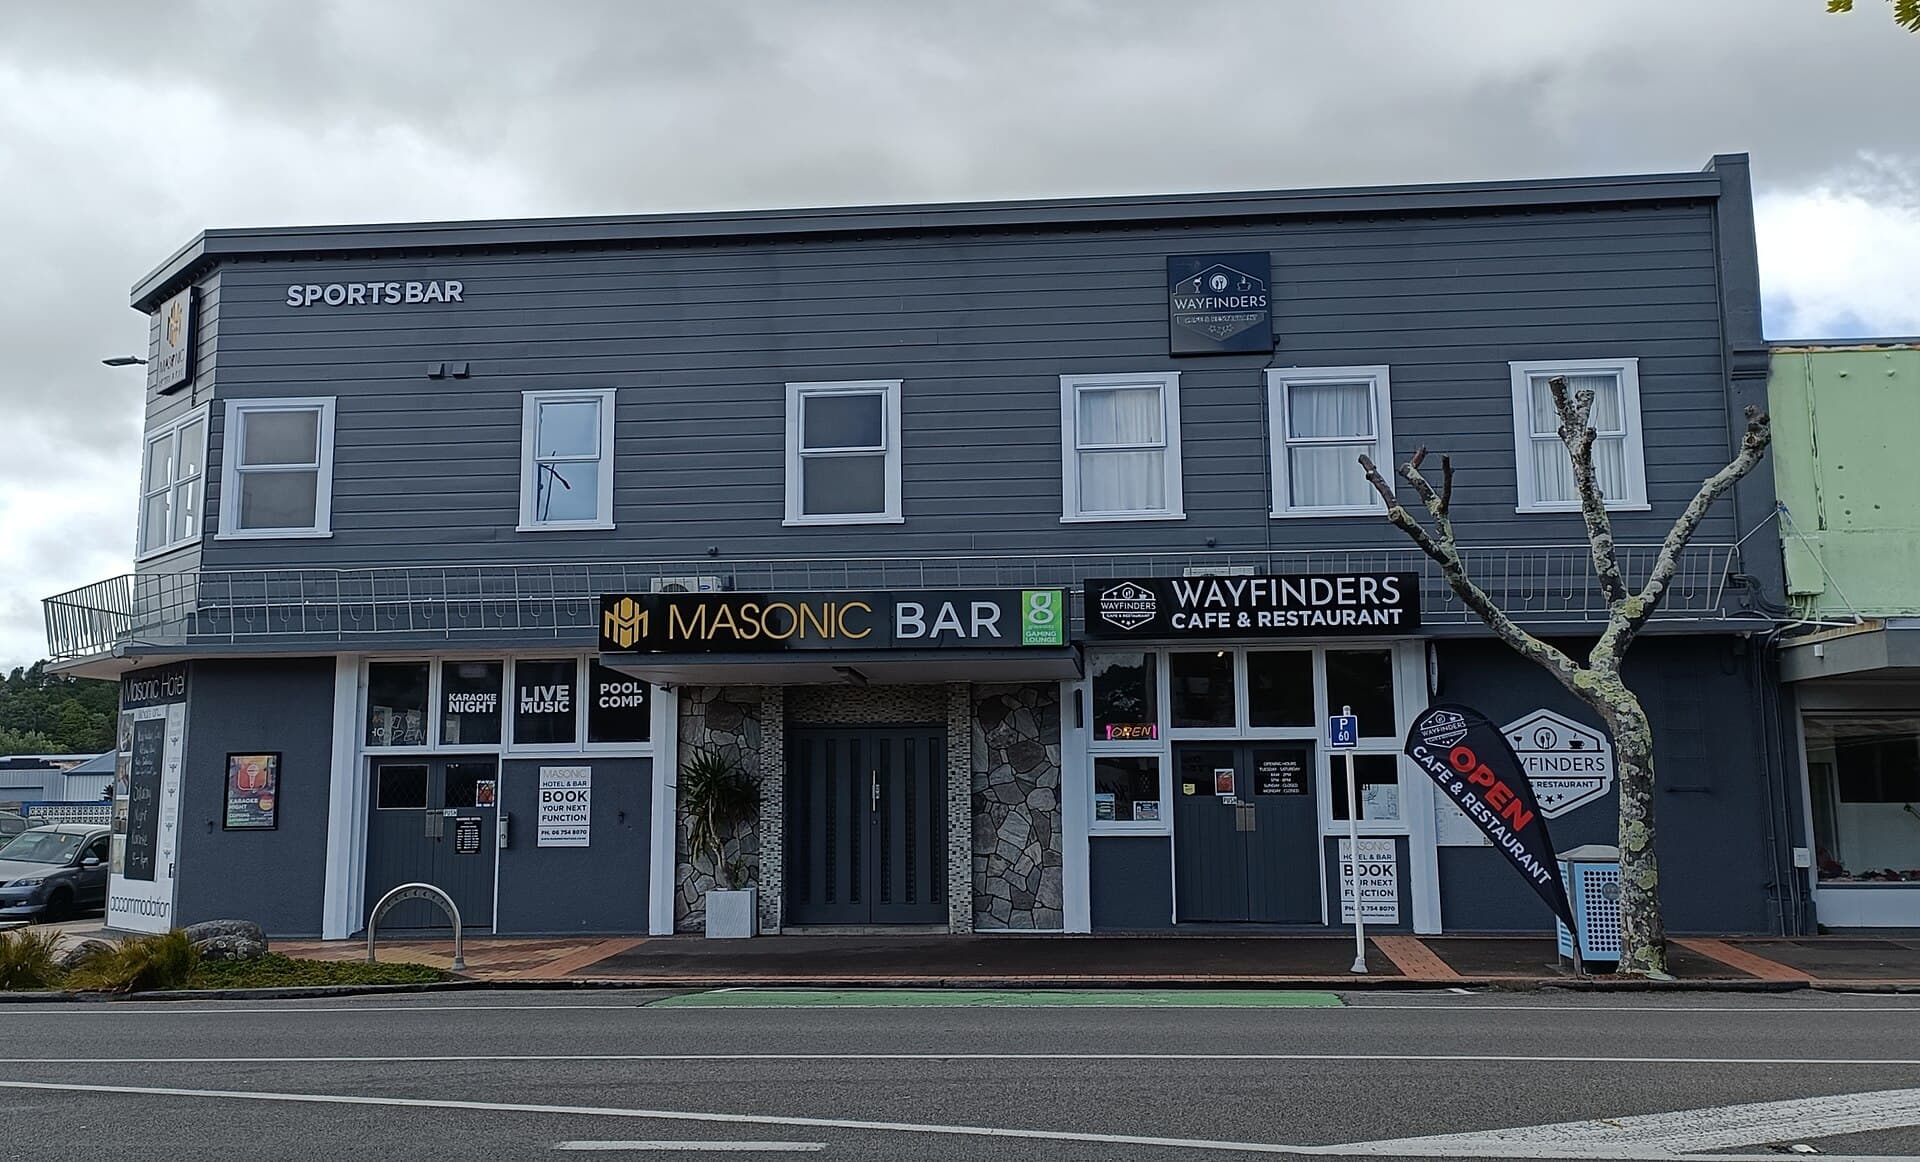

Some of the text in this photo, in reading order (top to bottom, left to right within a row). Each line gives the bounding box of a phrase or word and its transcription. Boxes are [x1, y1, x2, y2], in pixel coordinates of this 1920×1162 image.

[1174, 295, 1267, 310] WAYFINDERS
[1172, 577, 1400, 608] WAYFINDERS
[1101, 602, 1156, 610] WAYFINDERS
[669, 600, 1002, 641] MASONIC BAR
[1172, 608, 1403, 629] CAFE & RESTAURANT
[124, 668, 186, 703] Masonic Hotel
[600, 682, 642, 695] POOL
[449, 693, 497, 702] KARAOKE
[521, 685, 569, 701] LIVE
[449, 702, 497, 713] NIGHT
[520, 702, 569, 714] MUSIC
[599, 695, 643, 708] COMP
[1340, 718, 1349, 731] P
[1421, 721, 1466, 737] WAYFINDERS
[1111, 726, 1152, 738] OPEN
[1338, 730, 1350, 742] 60
[1521, 757, 1605, 772] FINDERS
[1449, 746, 1534, 832] OPEN
[542, 790, 588, 802] BOOK
[542, 814, 587, 822] FUNCTION
[1413, 746, 1454, 784] CAFE
[1450, 781, 1464, 796] &
[1461, 792, 1552, 885] RESTAURANT
[1343, 841, 1392, 850] MSONIC
[1344, 864, 1393, 876] BOOK
